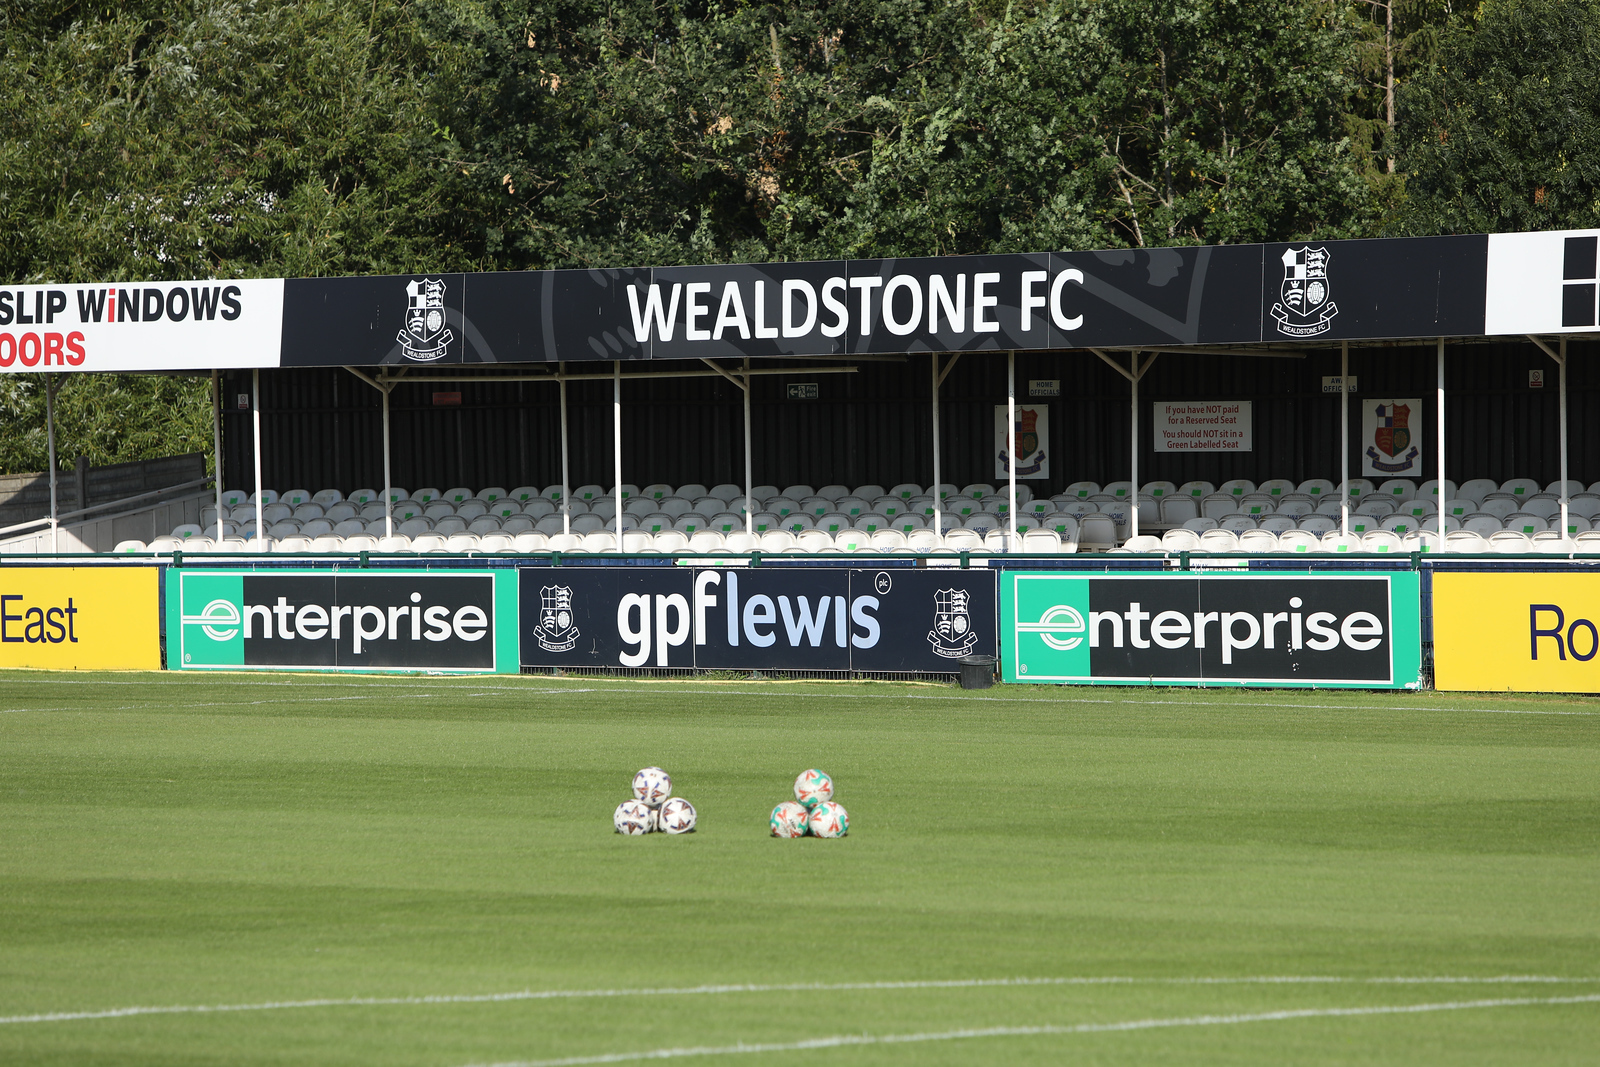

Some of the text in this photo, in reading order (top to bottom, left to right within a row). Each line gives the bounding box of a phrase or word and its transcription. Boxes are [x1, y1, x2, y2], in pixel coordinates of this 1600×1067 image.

[626, 268, 1084, 343] WEALDSTONE FC
[1282, 323, 1326, 335] WEALDSTONE FC
[406, 348, 443, 359] WEALDSTONE FC
[1165, 405, 1239, 415] If you have NOT paid
[1168, 416, 1178, 424] for
[1185, 416, 1219, 424] Reserved
[1220, 416, 1237, 424] Seat
[1162, 430, 1175, 438] You
[1177, 429, 1201, 438] should
[1203, 430, 1218, 438] NOT
[1219, 429, 1228, 437] sit
[1230, 429, 1238, 437] in
[1166, 440, 1239, 448] Green Labelled Seat
[879, 578, 888, 589] plc
[1, 594, 78, 644] East
[200, 592, 488, 654] enterprise
[1039, 596, 1384, 665] enterprise
